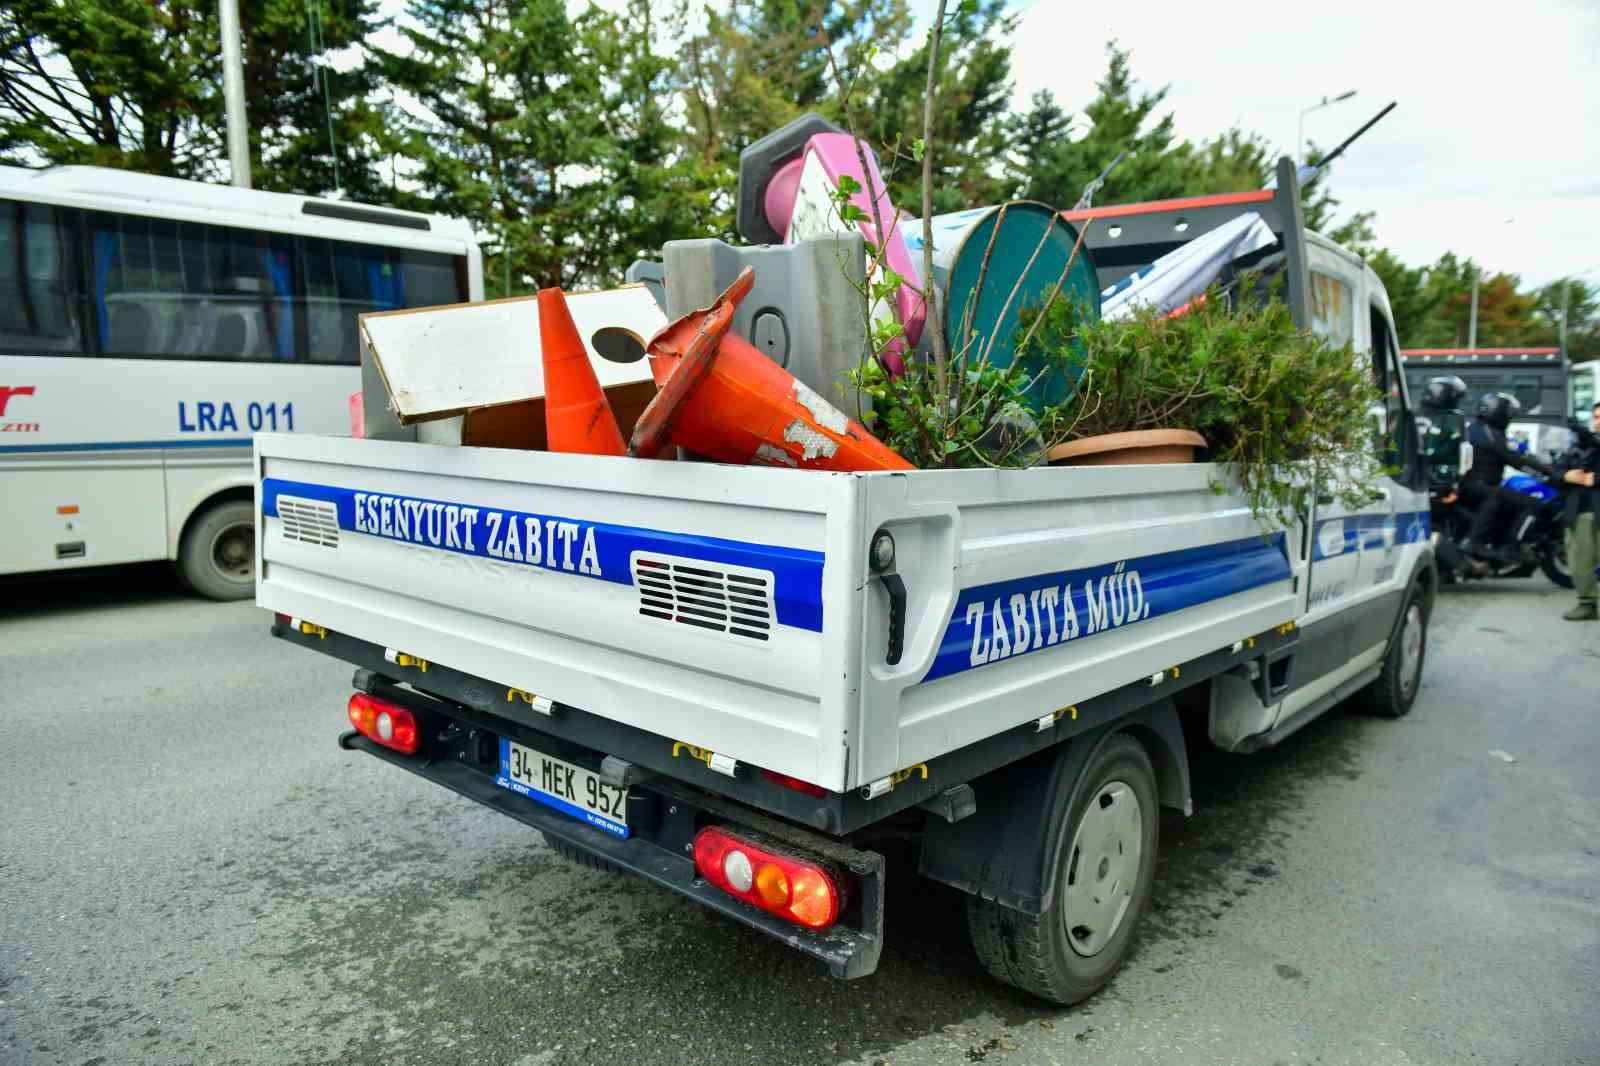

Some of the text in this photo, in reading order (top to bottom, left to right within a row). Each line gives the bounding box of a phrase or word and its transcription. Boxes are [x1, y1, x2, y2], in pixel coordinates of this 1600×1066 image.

[178, 401, 294, 432] LRA 011
[353, 493, 480, 551] ESENYURT
[486, 512, 602, 576] ZABITA
[966, 560, 1150, 667] ZABITA MÜD.
[511, 748, 627, 819] 34 MEK 952
